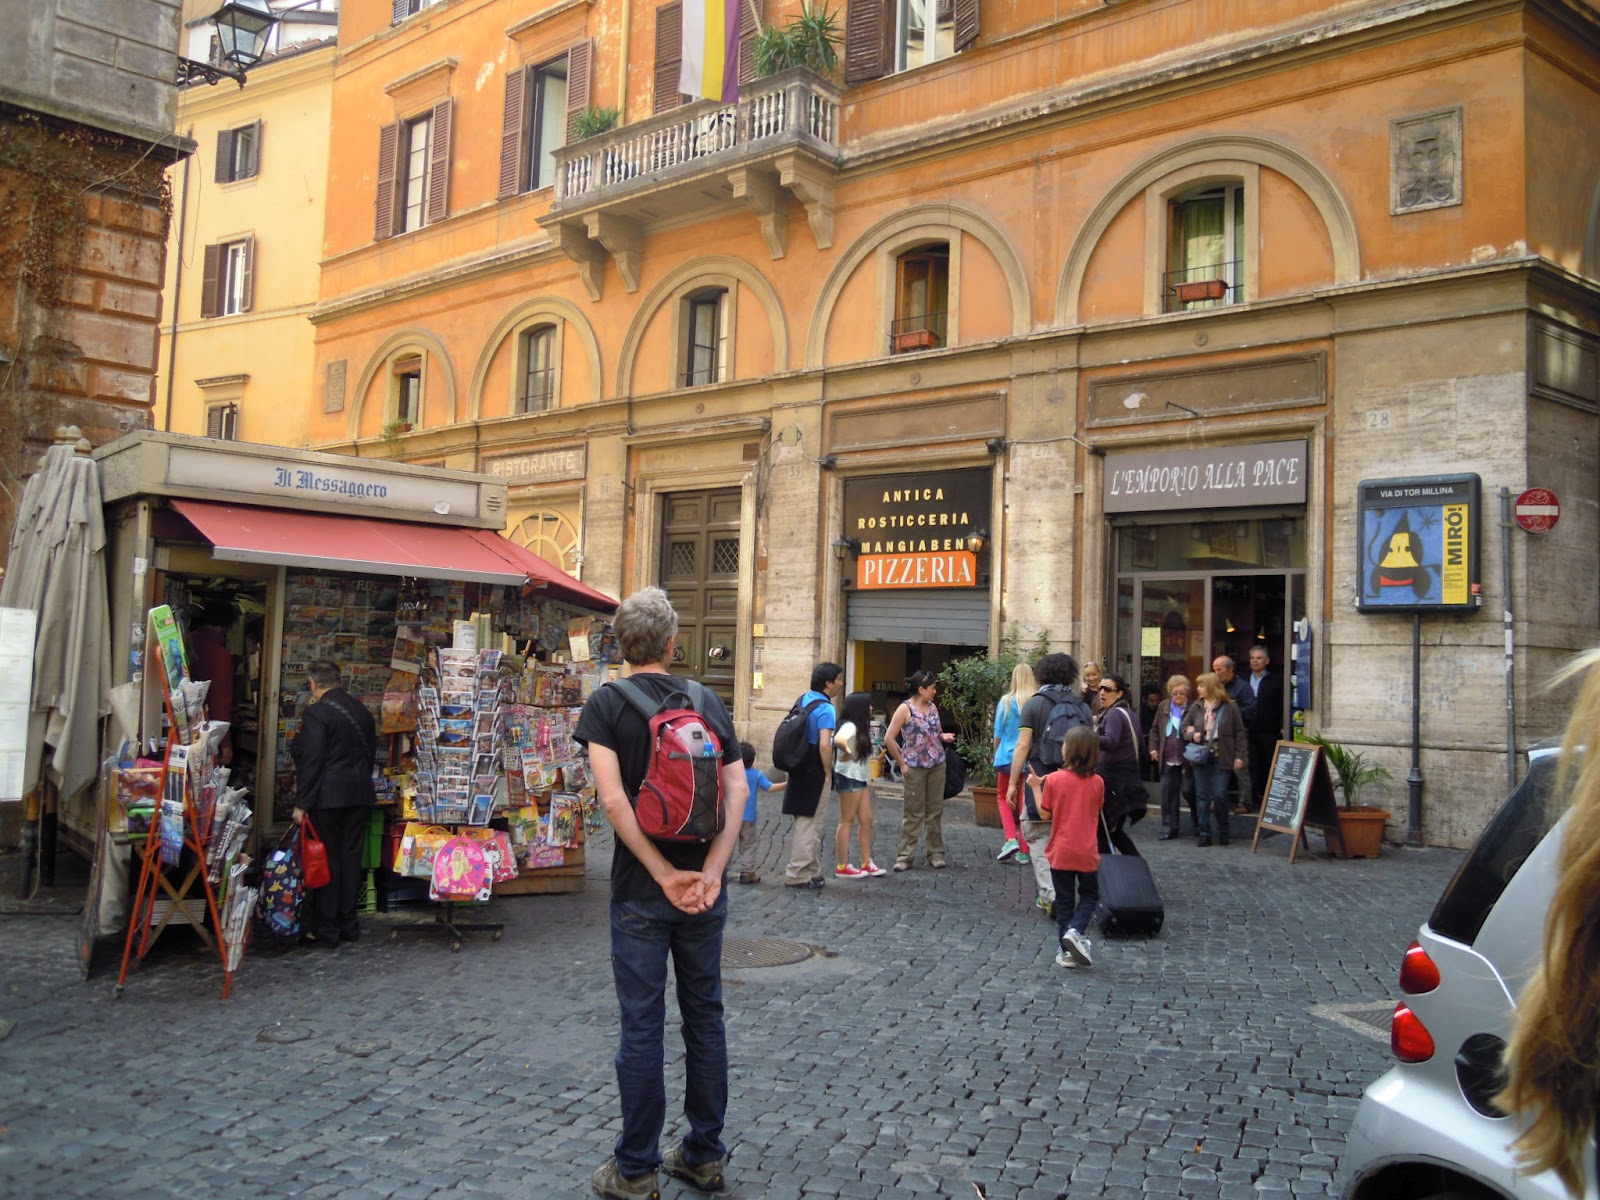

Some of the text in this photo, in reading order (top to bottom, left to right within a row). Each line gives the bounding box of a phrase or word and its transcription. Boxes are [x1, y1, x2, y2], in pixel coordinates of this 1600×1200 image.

[1369, 412, 1389, 427] 28
[493, 451, 576, 477] RISTORANTE
[296, 470, 387, 498] Messaggero
[1110, 457, 1299, 497] L'EMPORIO ALLA PACE
[882, 488, 944, 503] ANTICA
[1380, 486, 1454, 498] VIA DI TOR MILLINA
[858, 512, 969, 529] ROSTICCERIA
[864, 556, 972, 585] PIZZERIA
